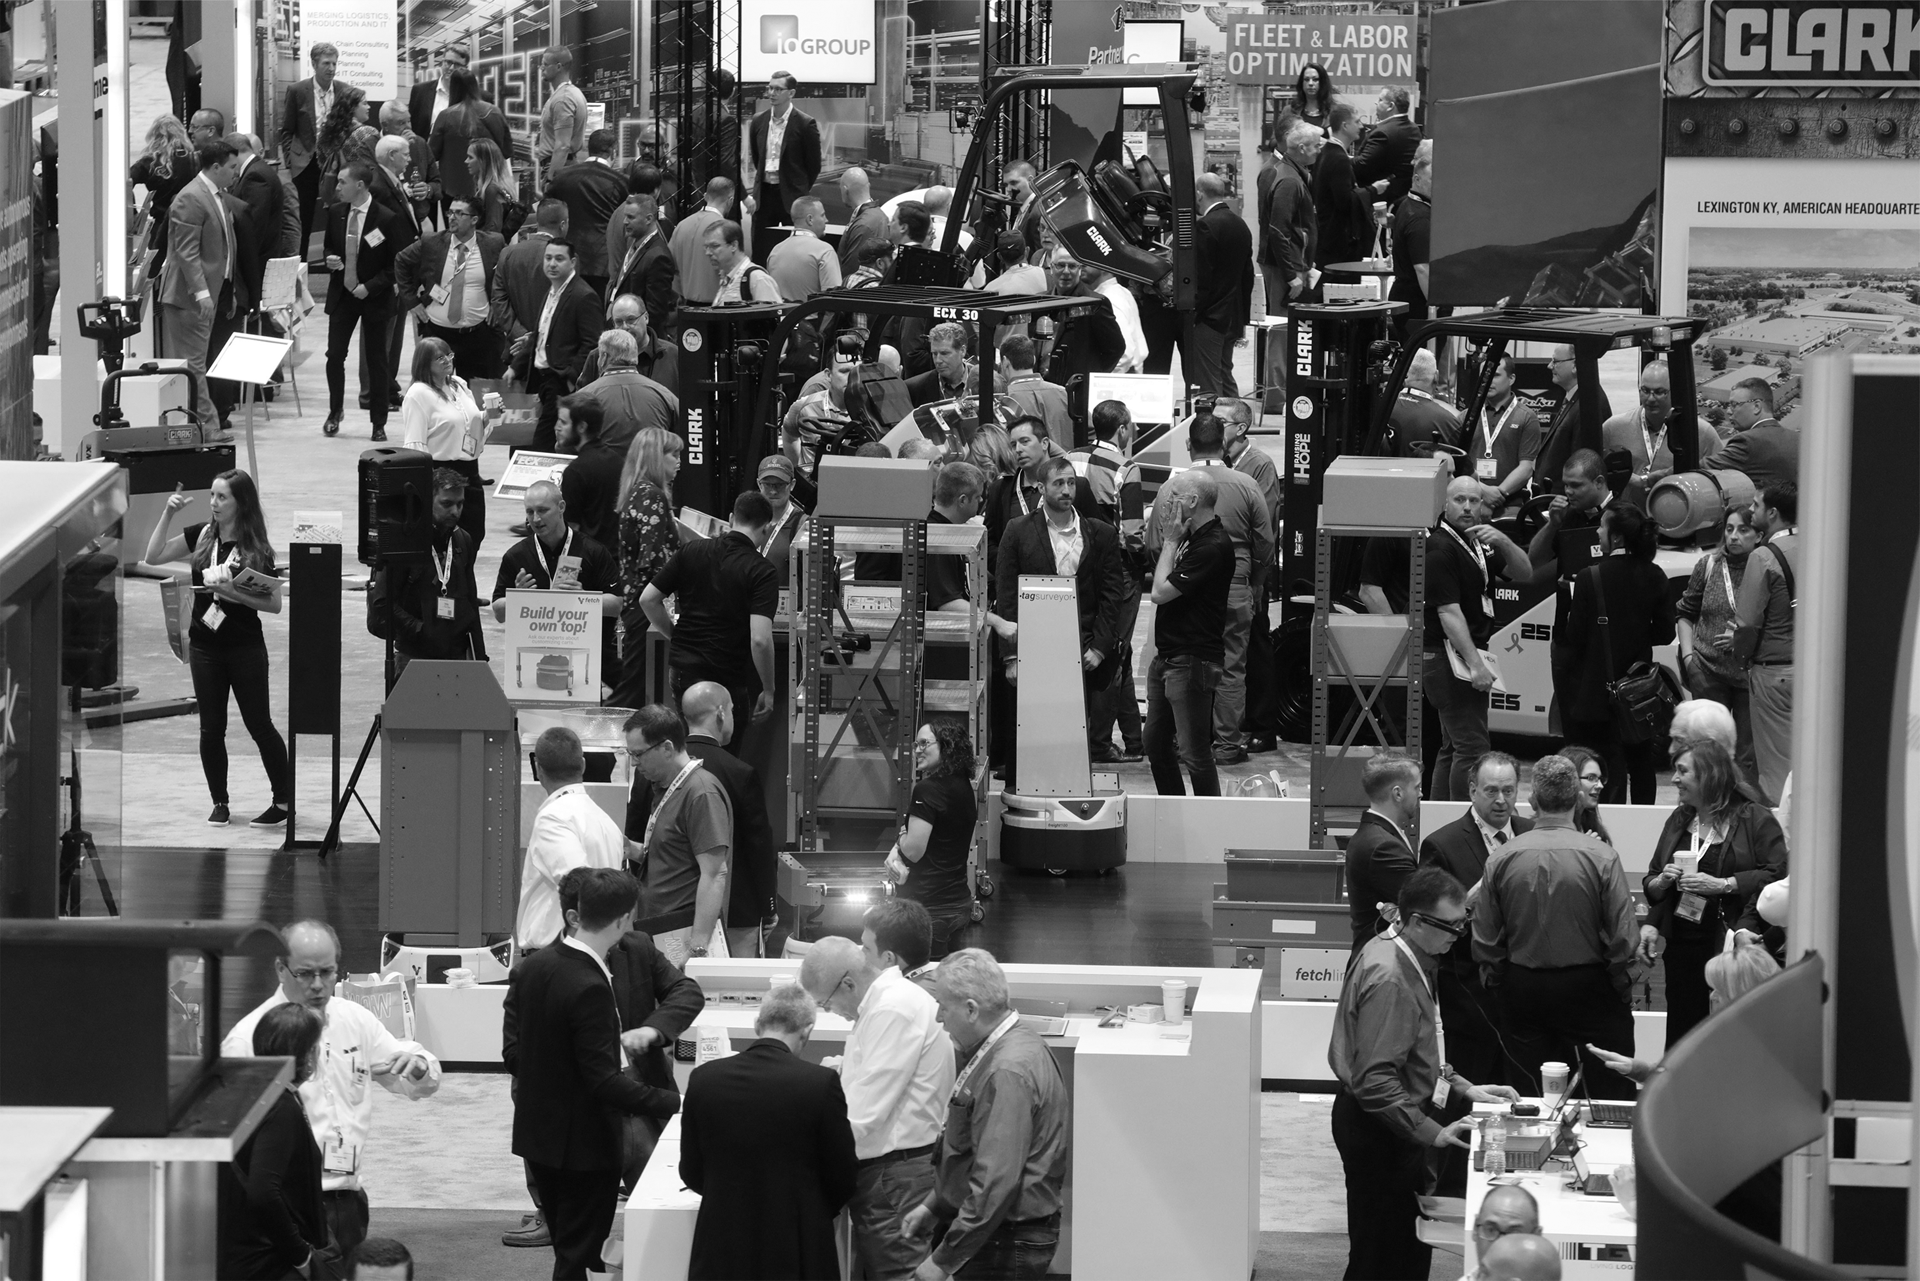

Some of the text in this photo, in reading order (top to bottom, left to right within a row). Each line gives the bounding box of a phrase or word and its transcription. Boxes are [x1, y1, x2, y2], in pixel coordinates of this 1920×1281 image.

[1235, 23, 1409, 48] FLEET & LABOR
[335, 40, 355, 48] Chain
[355, 41, 389, 49] Consulting
[341, 50, 369, 58] Planning
[337, 60, 365, 68] Planning
[349, 70, 383, 79] Consulting
[1697, 201, 1760, 214] LEXINGTON
[1762, 202, 1780, 216] KY,
[1782, 202, 1842, 215] AMERICAN
[1086, 225, 1113, 256] CLARK
[933, 306, 979, 321] ECX 30
[1296, 320, 1313, 376] CLARK
[170, 430, 192, 439] CLARK
[688, 408, 703, 465] CLARK
[1293, 433, 1311, 479] HOPE
[1021, 592, 1073, 602] tagsurveyor
[1495, 588, 1520, 601] LARK
[520, 606, 589, 623] Build your
[529, 620, 588, 636] own top!
